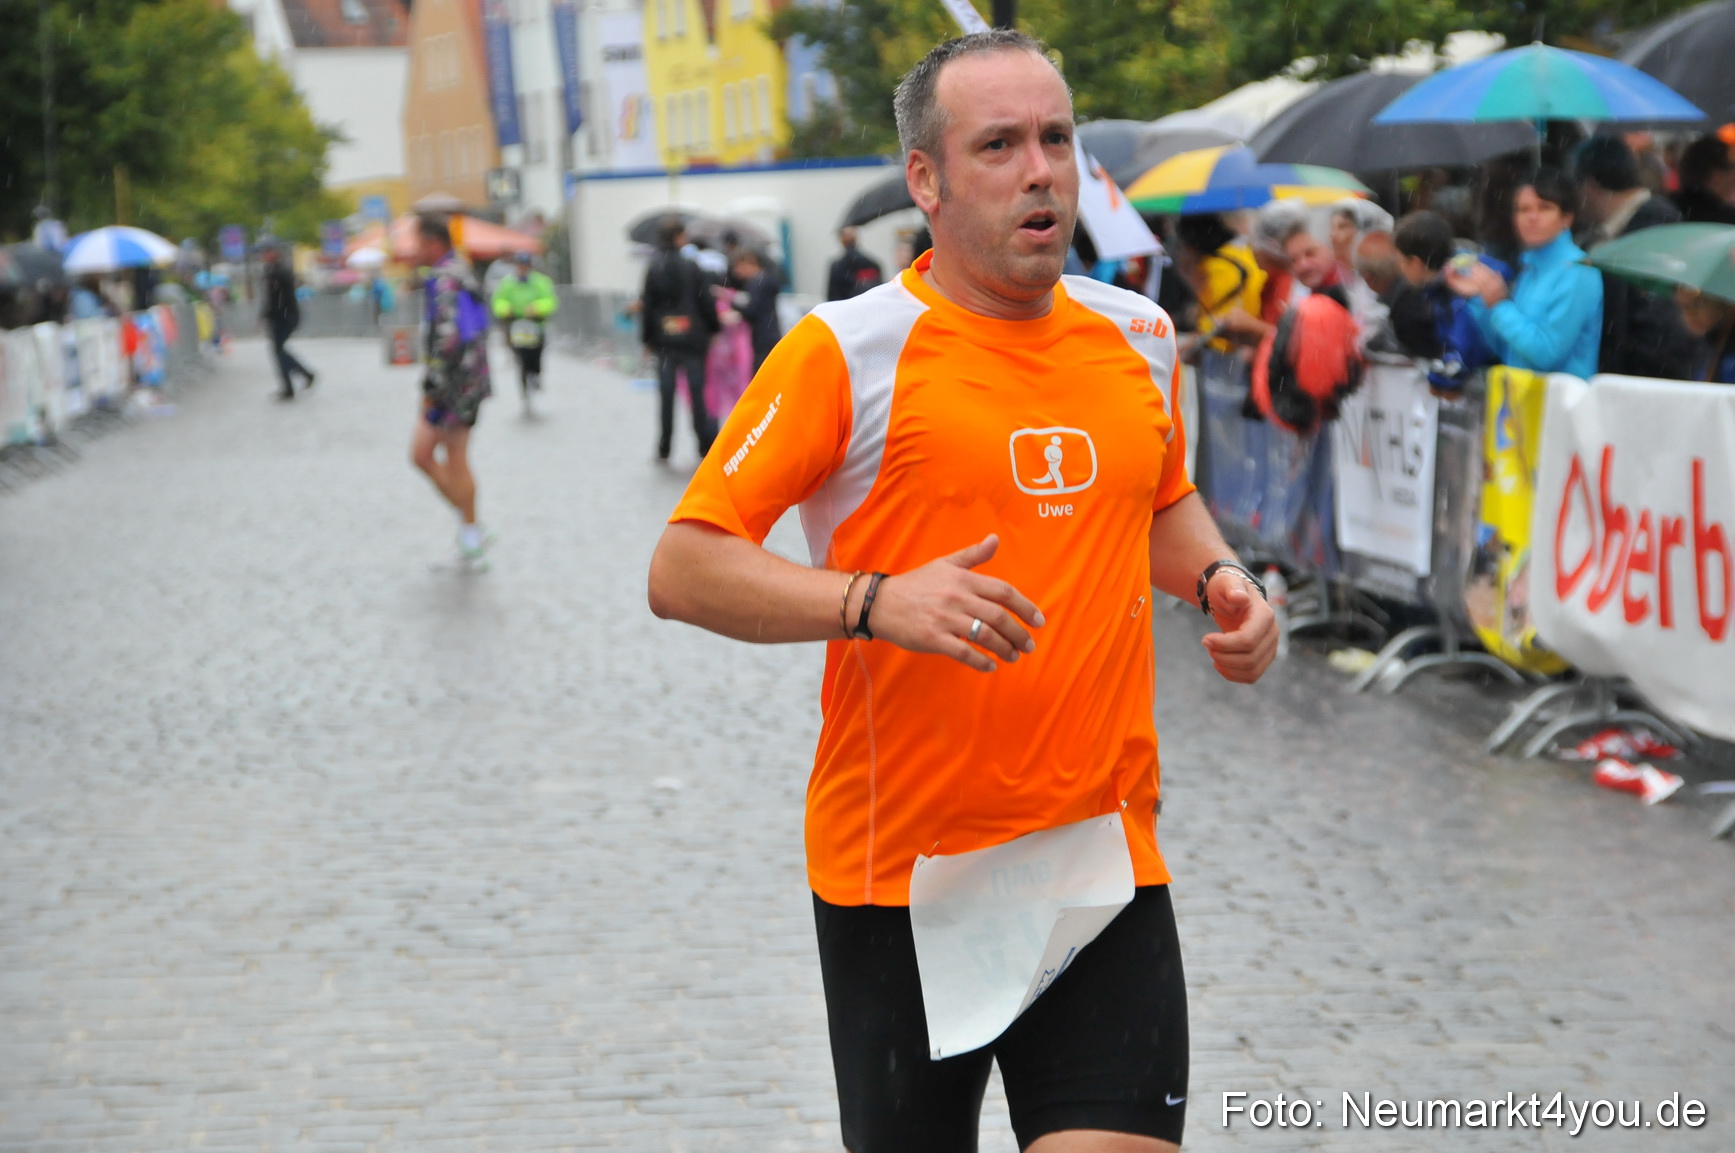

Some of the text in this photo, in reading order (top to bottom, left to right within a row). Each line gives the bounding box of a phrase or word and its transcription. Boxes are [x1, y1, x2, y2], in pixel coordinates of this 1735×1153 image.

[1129, 317, 1168, 339] s:b
[1037, 502, 1074, 518] Uwe
[1554, 442, 1735, 643] Oberb
